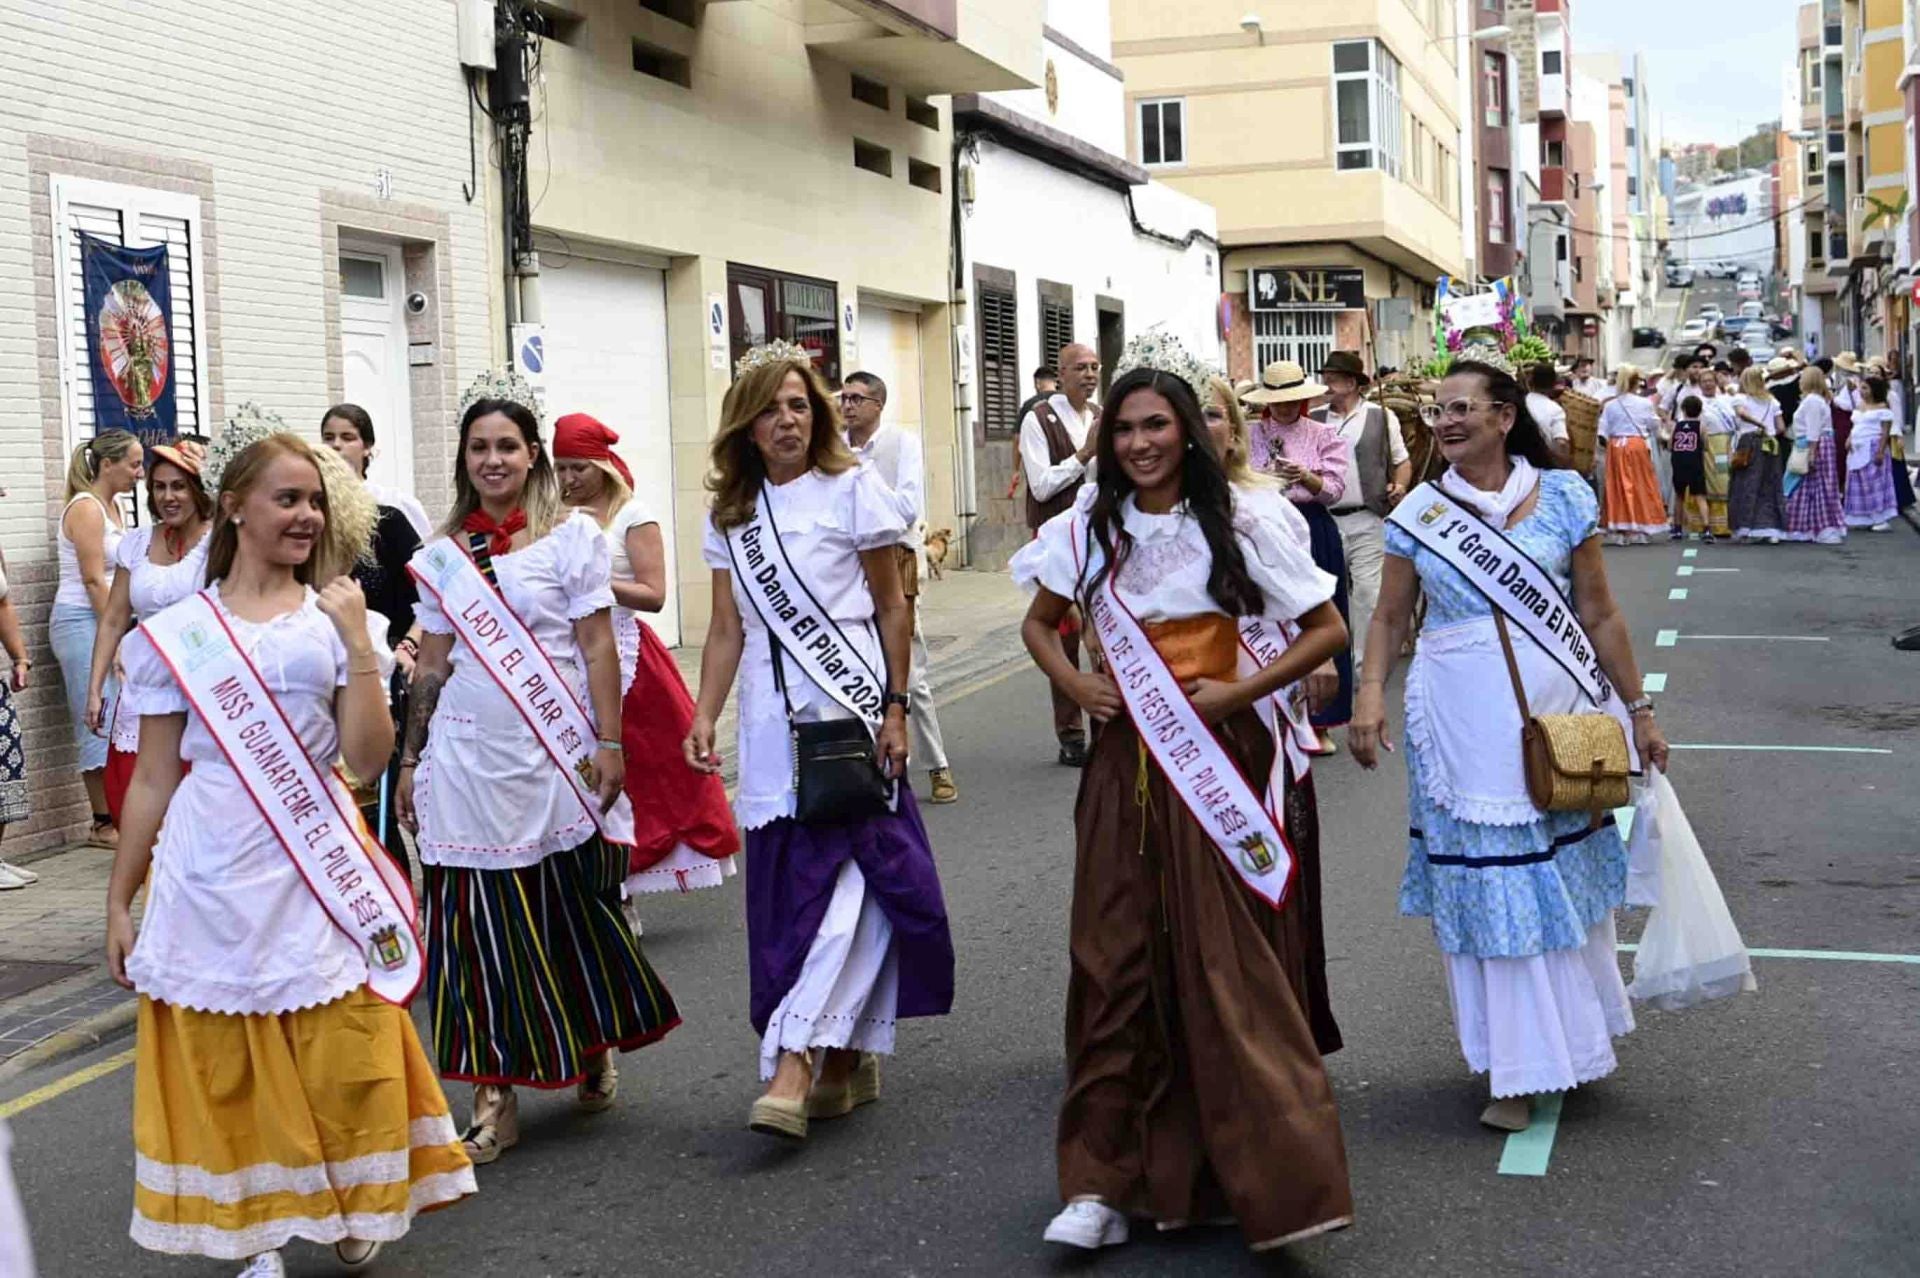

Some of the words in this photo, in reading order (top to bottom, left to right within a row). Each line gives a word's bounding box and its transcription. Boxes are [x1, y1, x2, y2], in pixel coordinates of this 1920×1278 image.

[1286, 271, 1338, 302] NL
[1673, 431, 1698, 452] 23
[740, 524, 766, 571] Gran
[756, 563, 798, 622] Dama
[790, 614, 820, 642] El
[807, 632, 851, 681] Pilar
[1458, 532, 1502, 576] Gran
[1496, 561, 1549, 618] Dama
[1545, 604, 1566, 635] El
[1561, 623, 1590, 668] Pilar
[1111, 635, 1134, 660] DE
[1241, 621, 1279, 664] PILAR
[461, 599, 508, 647] LADY
[499, 648, 527, 676] EL
[521, 673, 563, 726] PILAR
[556, 725, 582, 755] 2025
[1121, 656, 1152, 690] LAS
[1137, 686, 1185, 744] FIESTAS
[1168, 739, 1202, 773] DEL
[209, 675, 254, 721] MISS
[238, 720, 319, 825] GUANARTEME
[304, 821, 332, 849] EL
[319, 845, 363, 897] PILAR
[348, 891, 383, 928] 2025
[1188, 766, 1230, 812] PILAR
[1214, 804, 1248, 836] 2025
